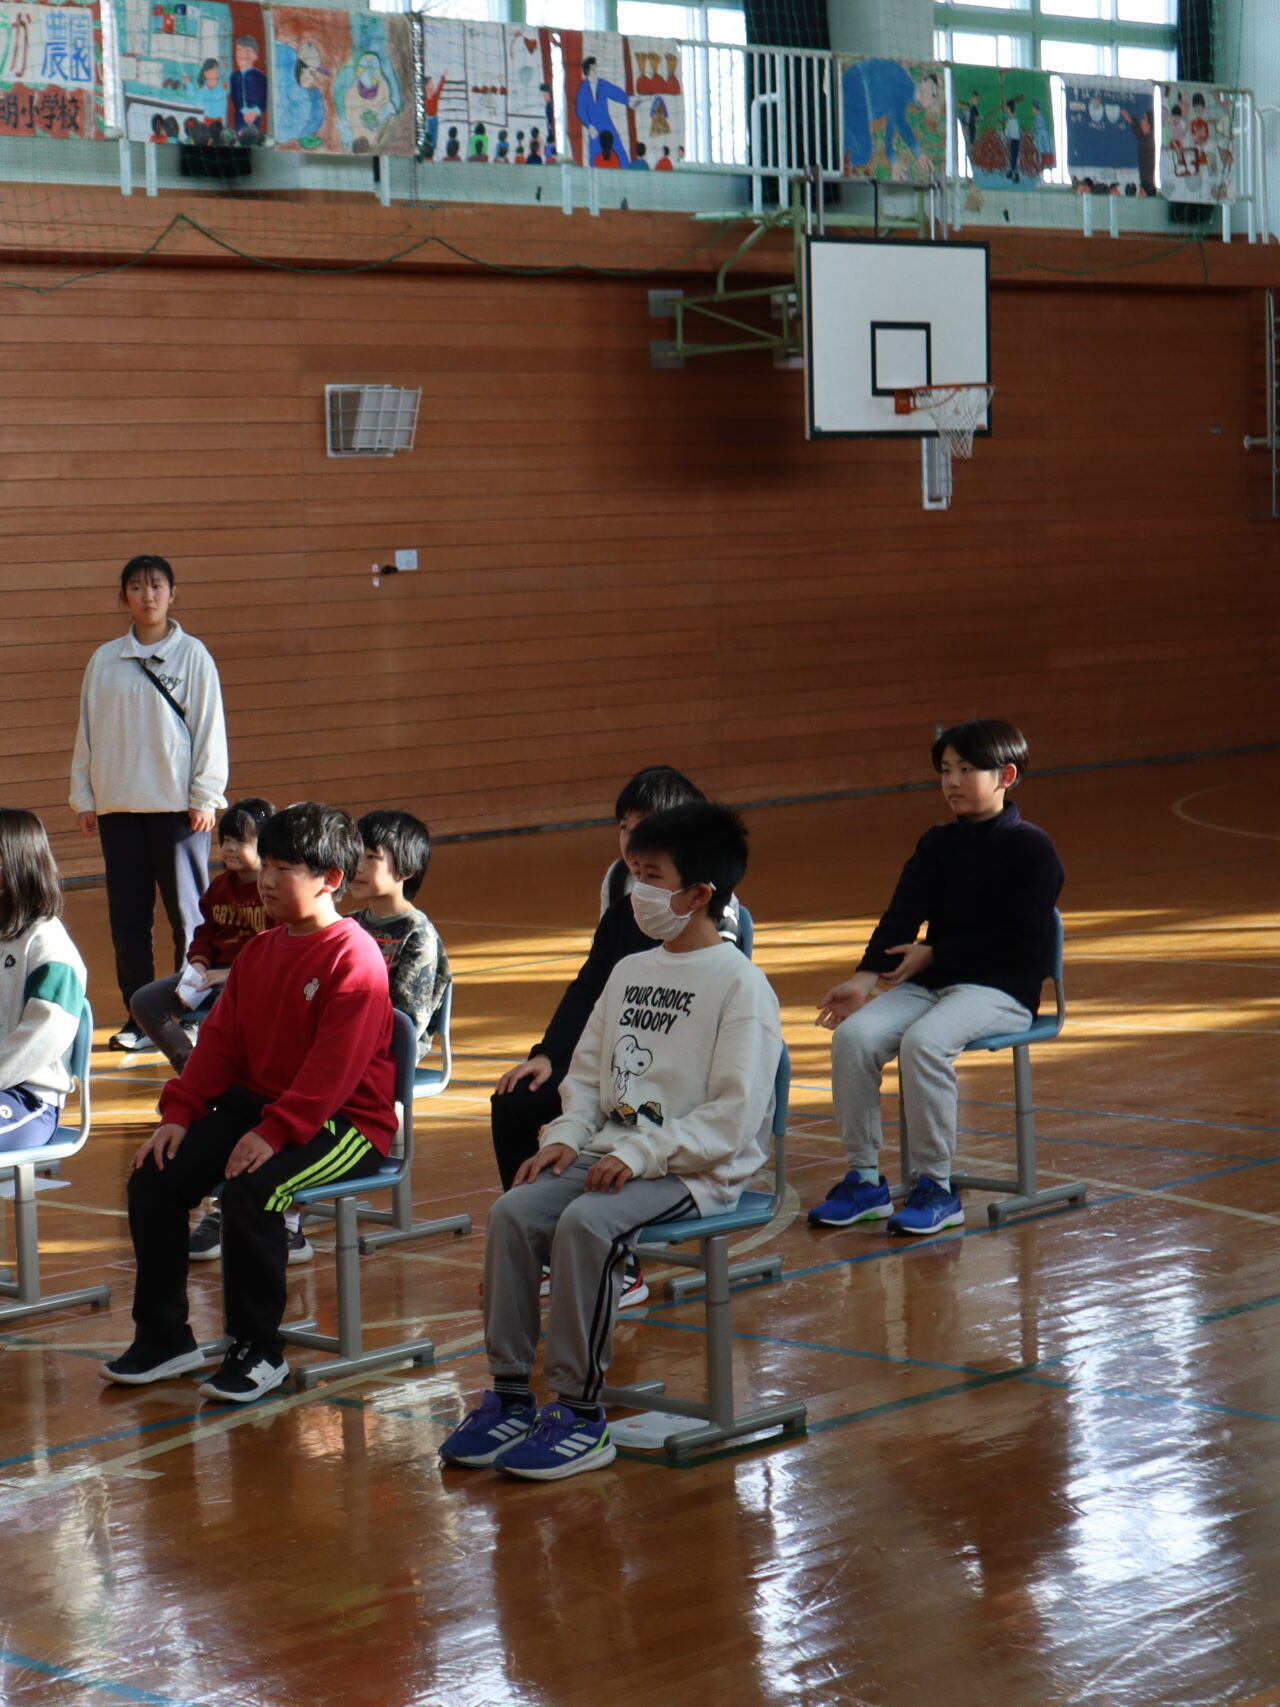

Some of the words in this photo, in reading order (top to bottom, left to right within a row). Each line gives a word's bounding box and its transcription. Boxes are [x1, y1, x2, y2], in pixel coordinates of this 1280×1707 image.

[622, 985, 653, 1007] YOUR
[651, 986, 696, 1017] CHOICE,
[619, 1007, 678, 1035] SNOOPY
